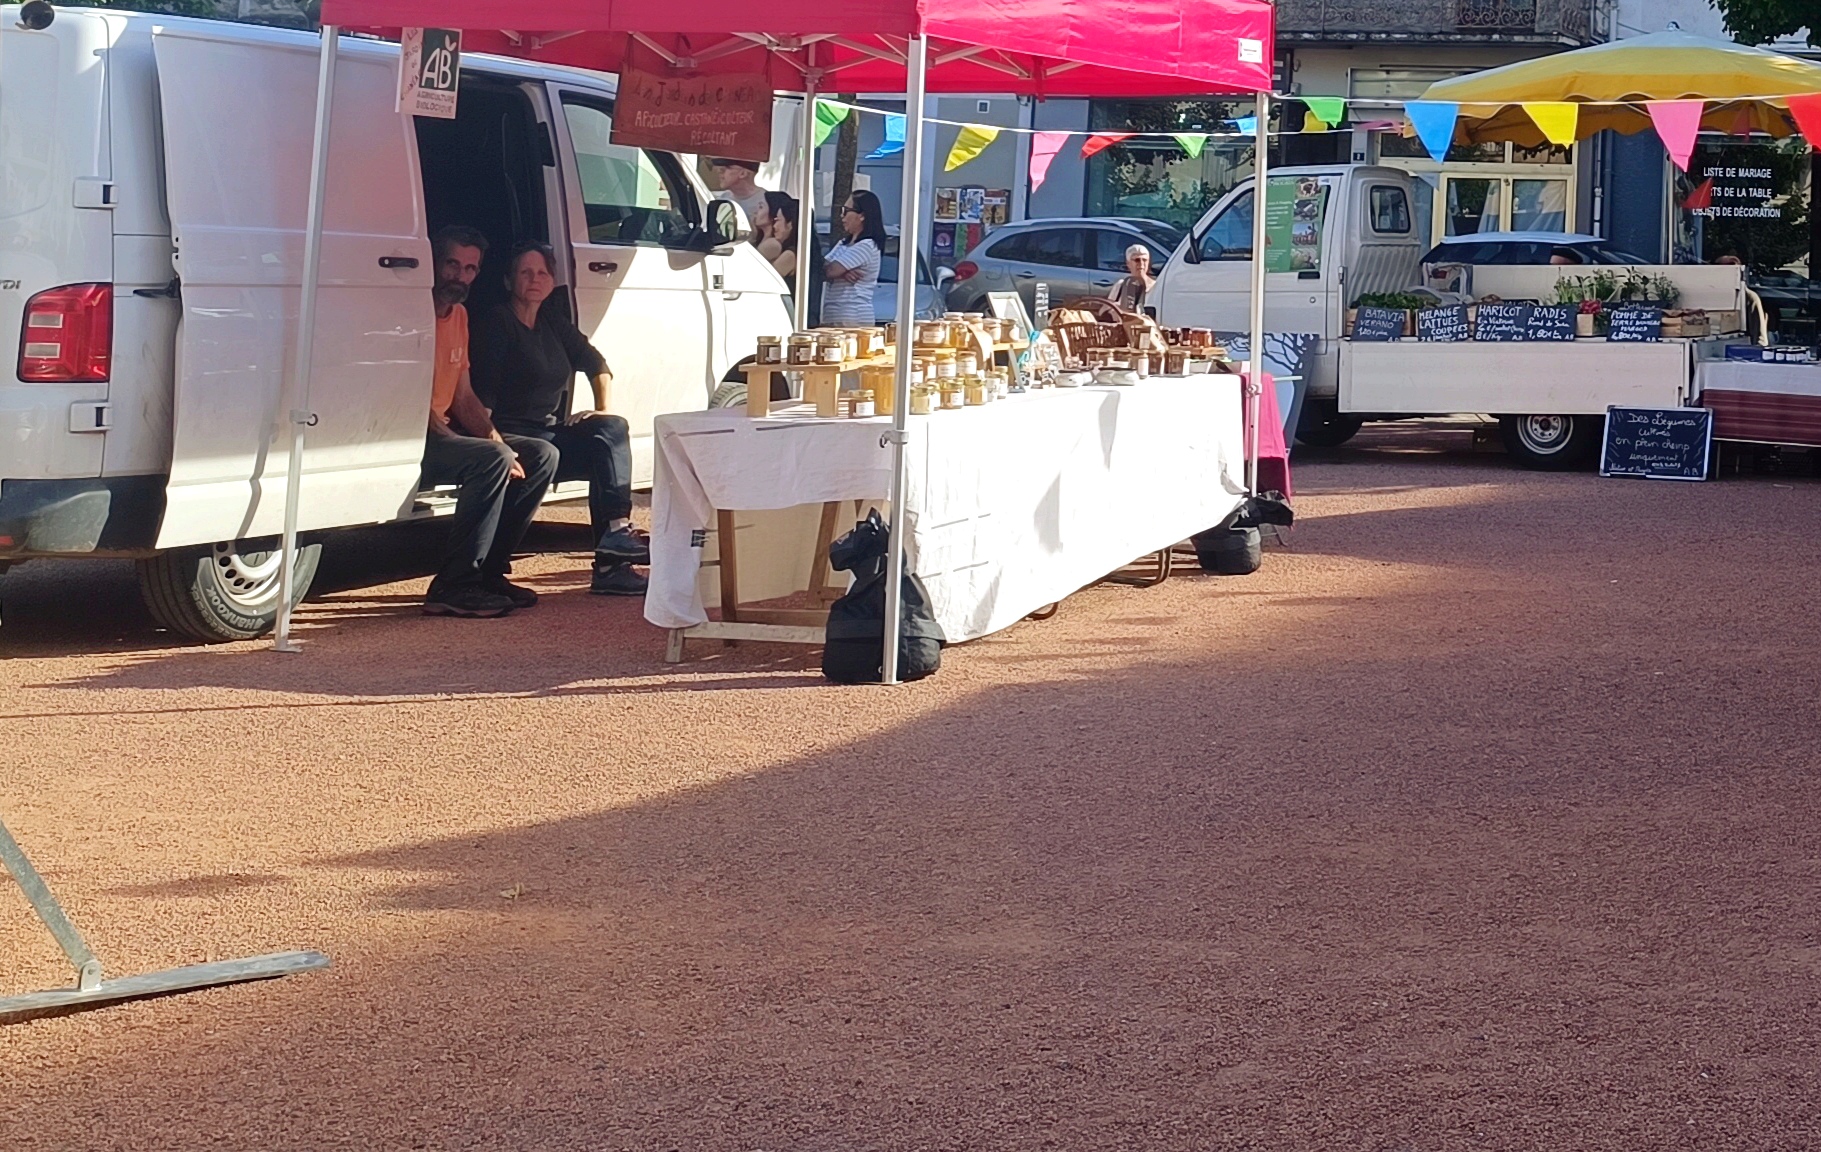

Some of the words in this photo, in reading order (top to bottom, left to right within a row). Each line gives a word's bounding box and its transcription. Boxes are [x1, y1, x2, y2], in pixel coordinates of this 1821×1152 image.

[421, 47, 452, 88] AB
[1703, 167, 1724, 177] LISTE
[1725, 168, 1736, 178] DE
[1738, 168, 1772, 179] MARIAGE
[1724, 188, 1735, 197] DE
[1736, 188, 1747, 198] LA
[1748, 188, 1772, 199] TABLE
[1722, 207, 1732, 217] DE
[1733, 205, 1781, 218] DÉCORATION
[1364, 309, 1405, 322] BATAVIA
[1478, 305, 1523, 317] HARICOT
[1533, 307, 1567, 320] RADIS
[1611, 310, 1639, 319] POMME
[1641, 312, 1655, 320] DE
[1360, 319, 1394, 329] VERANO
[1616, 437, 1631, 445] en
